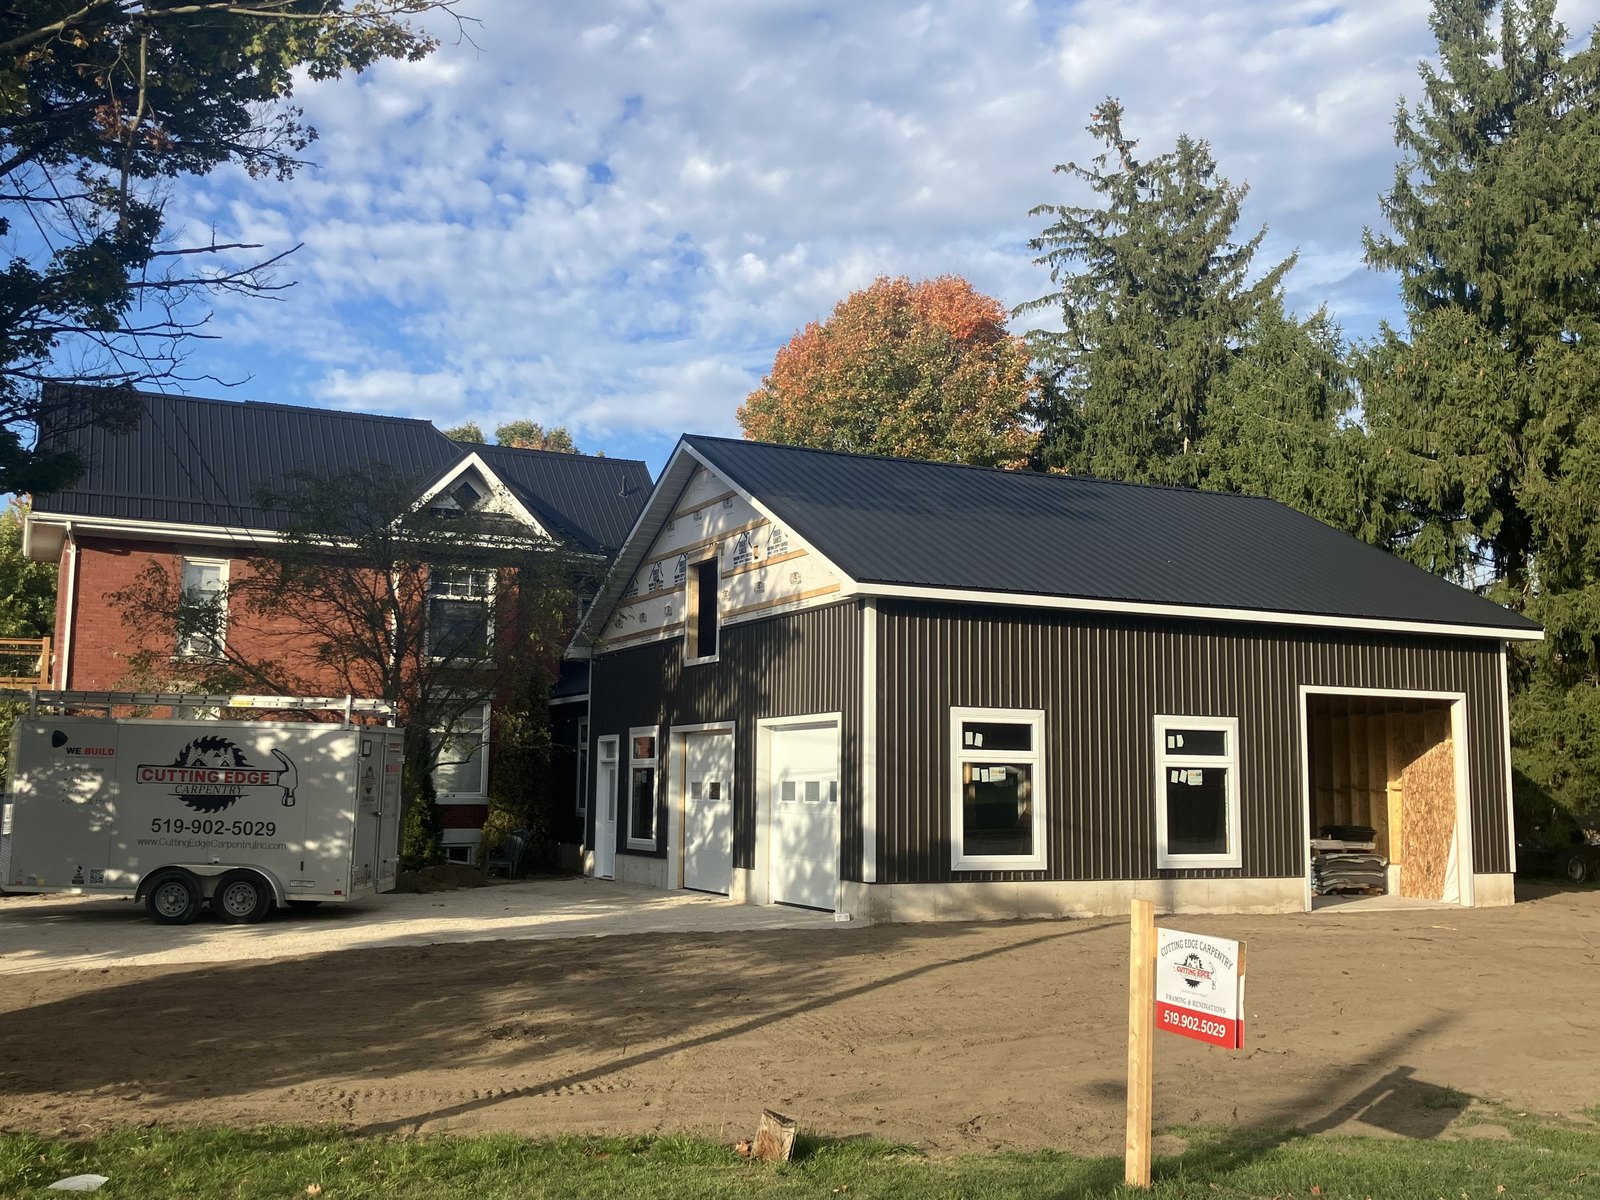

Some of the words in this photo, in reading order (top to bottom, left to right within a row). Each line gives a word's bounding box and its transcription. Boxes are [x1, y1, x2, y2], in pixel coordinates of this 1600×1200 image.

[66, 747, 82, 755] WE
[84, 747, 115, 756] BUILD
[142, 768, 219, 782] CUTTING
[224, 771, 270, 784] EDGE
[175, 785, 245, 795] CARPENTRY
[151, 818, 277, 836] 519-902-5029
[1160, 940, 1184, 957] CUTTING
[1184, 939, 1199, 949] EDGE
[1199, 941, 1233, 970] CARPENTRY
[1176, 966, 1196, 976] CUTTING
[1197, 969, 1211, 979] EDGE
[1165, 993, 1187, 1005] FRAMING
[1192, 1000, 1226, 1014] RENOVATIONS
[1163, 1010, 1226, 1038] 519.902.5029
